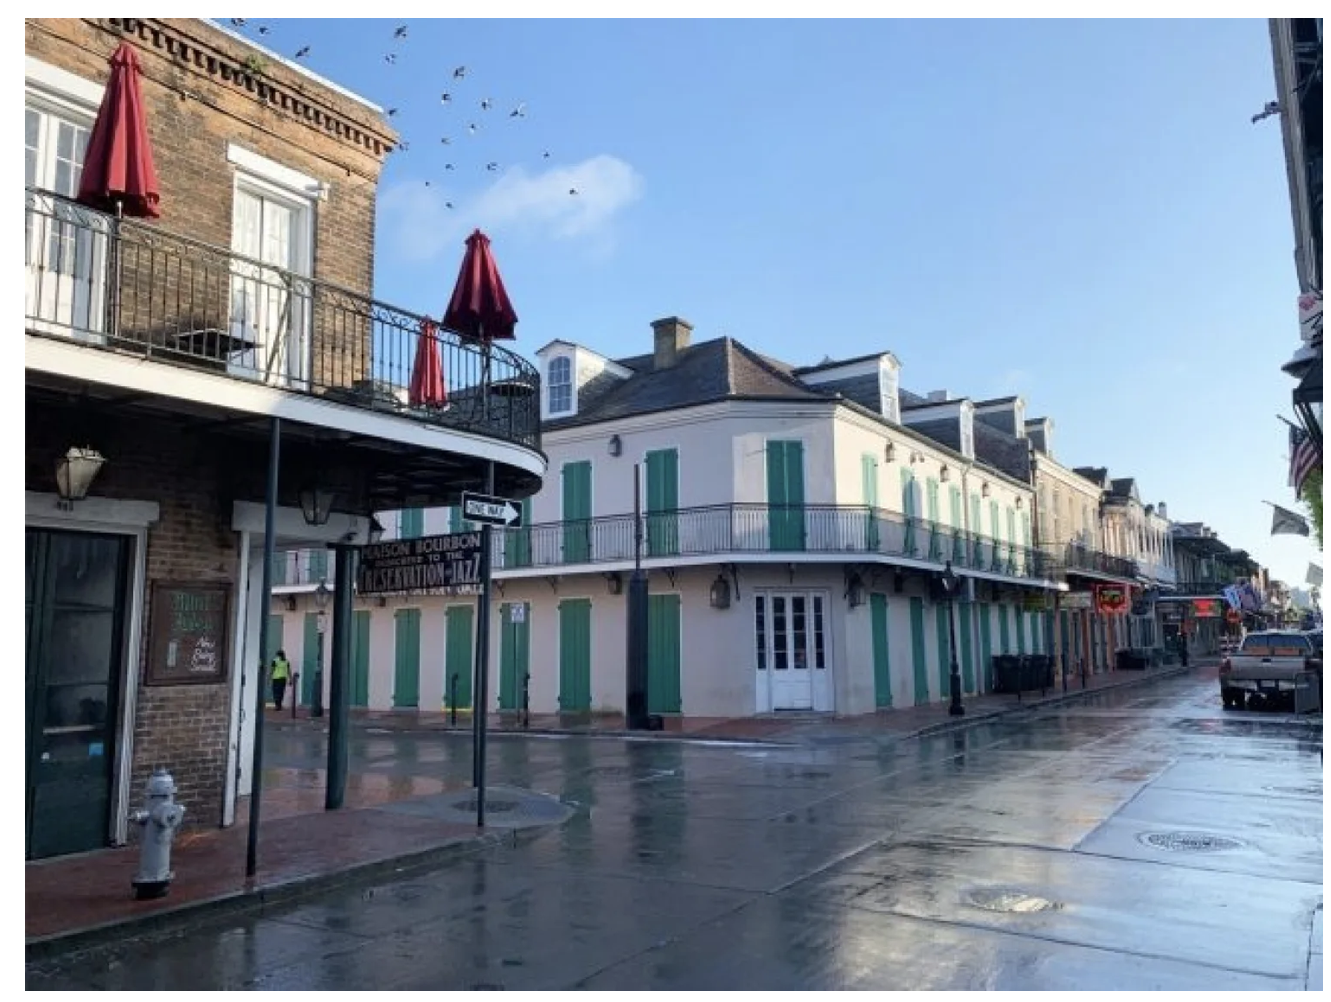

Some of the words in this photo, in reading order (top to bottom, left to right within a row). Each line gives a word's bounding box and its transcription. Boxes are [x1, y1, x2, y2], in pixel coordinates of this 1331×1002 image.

[415, 533, 480, 553] BOURBON
[428, 553, 440, 562] TO
[449, 552, 481, 585] JAZZ
